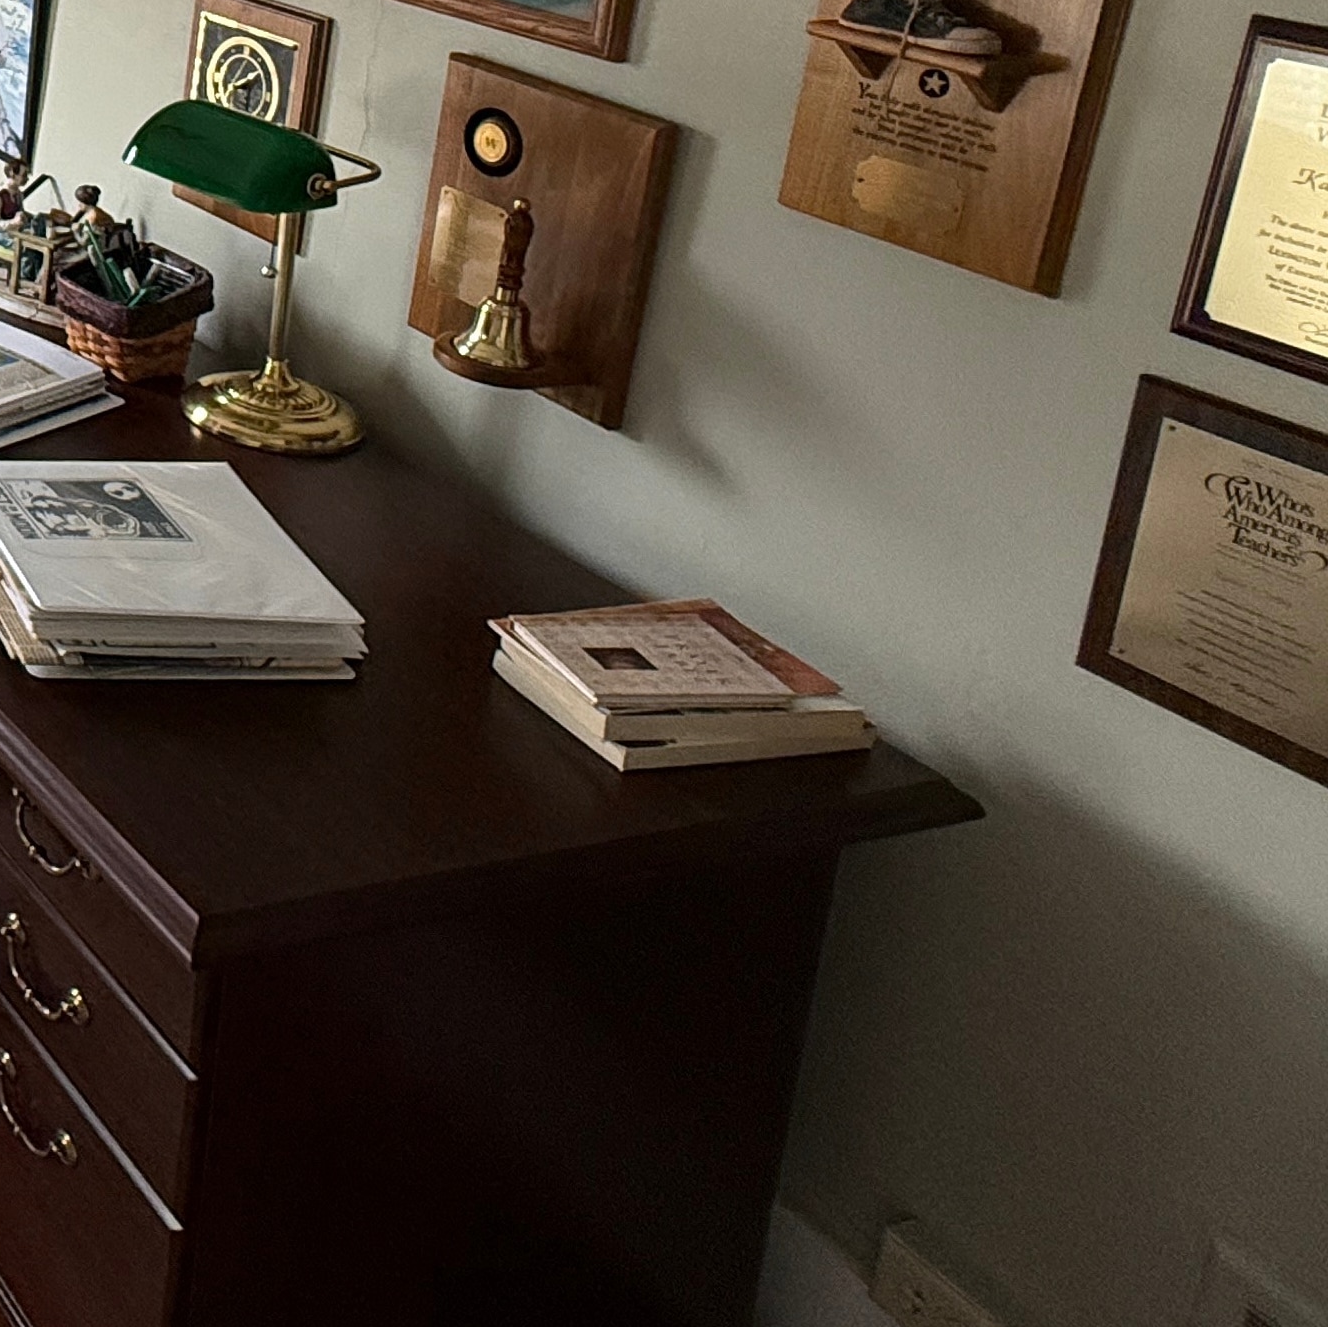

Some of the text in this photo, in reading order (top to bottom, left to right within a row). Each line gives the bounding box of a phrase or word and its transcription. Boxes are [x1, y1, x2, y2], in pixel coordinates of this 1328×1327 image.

[1205, 473, 1268, 517] Who
[1254, 480, 1316, 518] Who's
[1227, 521, 1300, 568] Teachers
